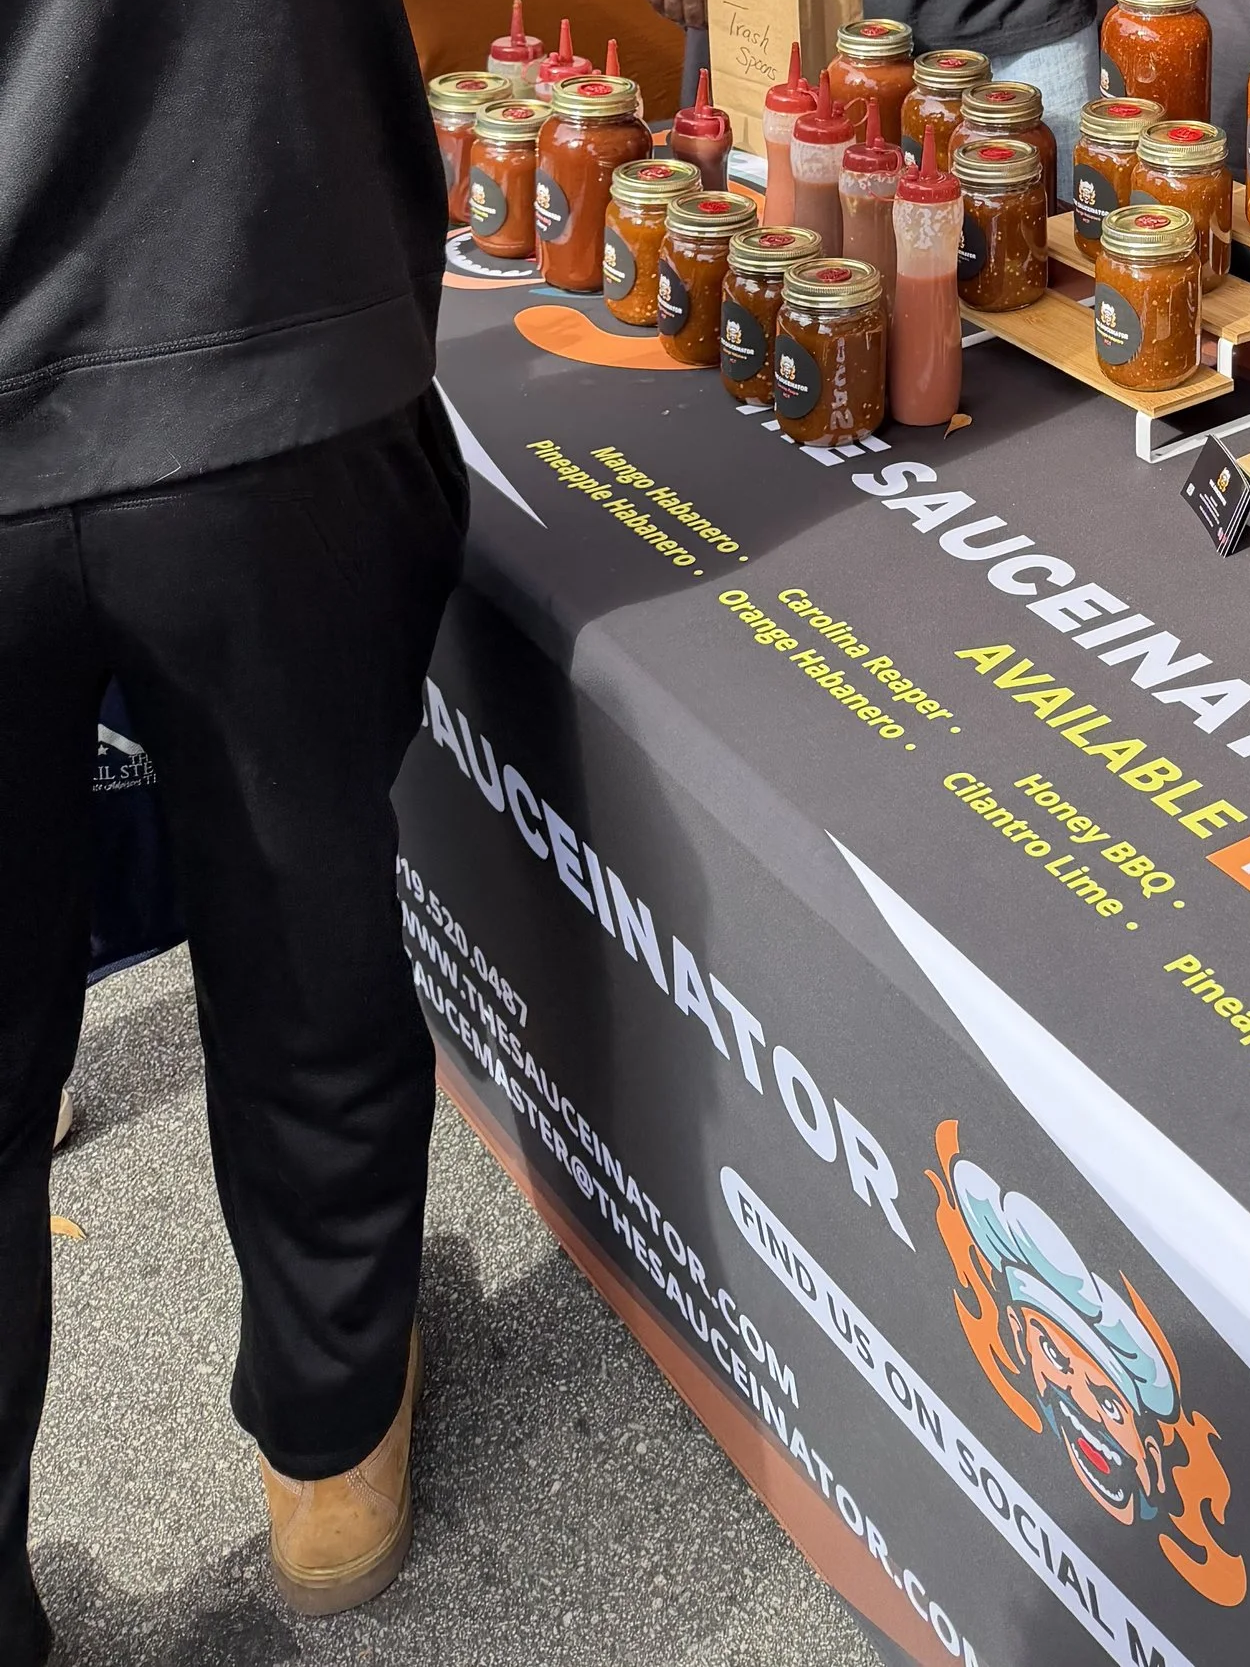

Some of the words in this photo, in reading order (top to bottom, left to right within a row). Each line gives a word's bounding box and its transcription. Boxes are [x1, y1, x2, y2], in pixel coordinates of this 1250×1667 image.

[736, 47, 778, 81] Spoons
[526, 439, 613, 503] Pineapple
[602, 496, 697, 568] Habanero
[590, 446, 654, 493] Mango
[646, 485, 740, 556] Habanero
[718, 589, 799, 653] Orange
[790, 648, 905, 740] Habanero
[777, 587, 870, 659] Carolina
[862, 655, 955, 722] Reaper
[954, 643, 1248, 840] AVAILABLE
[942, 770, 1052, 858] Cilantro
[1045, 854, 1124, 919] Lime
[1014, 773, 1110, 845] Honey
[1101, 840, 1176, 899] BBQ
[421, 676, 916, 1253] AUCEINATOR
[404, 945, 979, 1667] AUCEMASTER@THESAUCEINATOR.CO
[736, 1191, 818, 1302] FIND
[827, 1308, 875, 1371] US
[884, 1367, 945, 1451] ON
[956, 1446, 1115, 1642] SOCIAL
